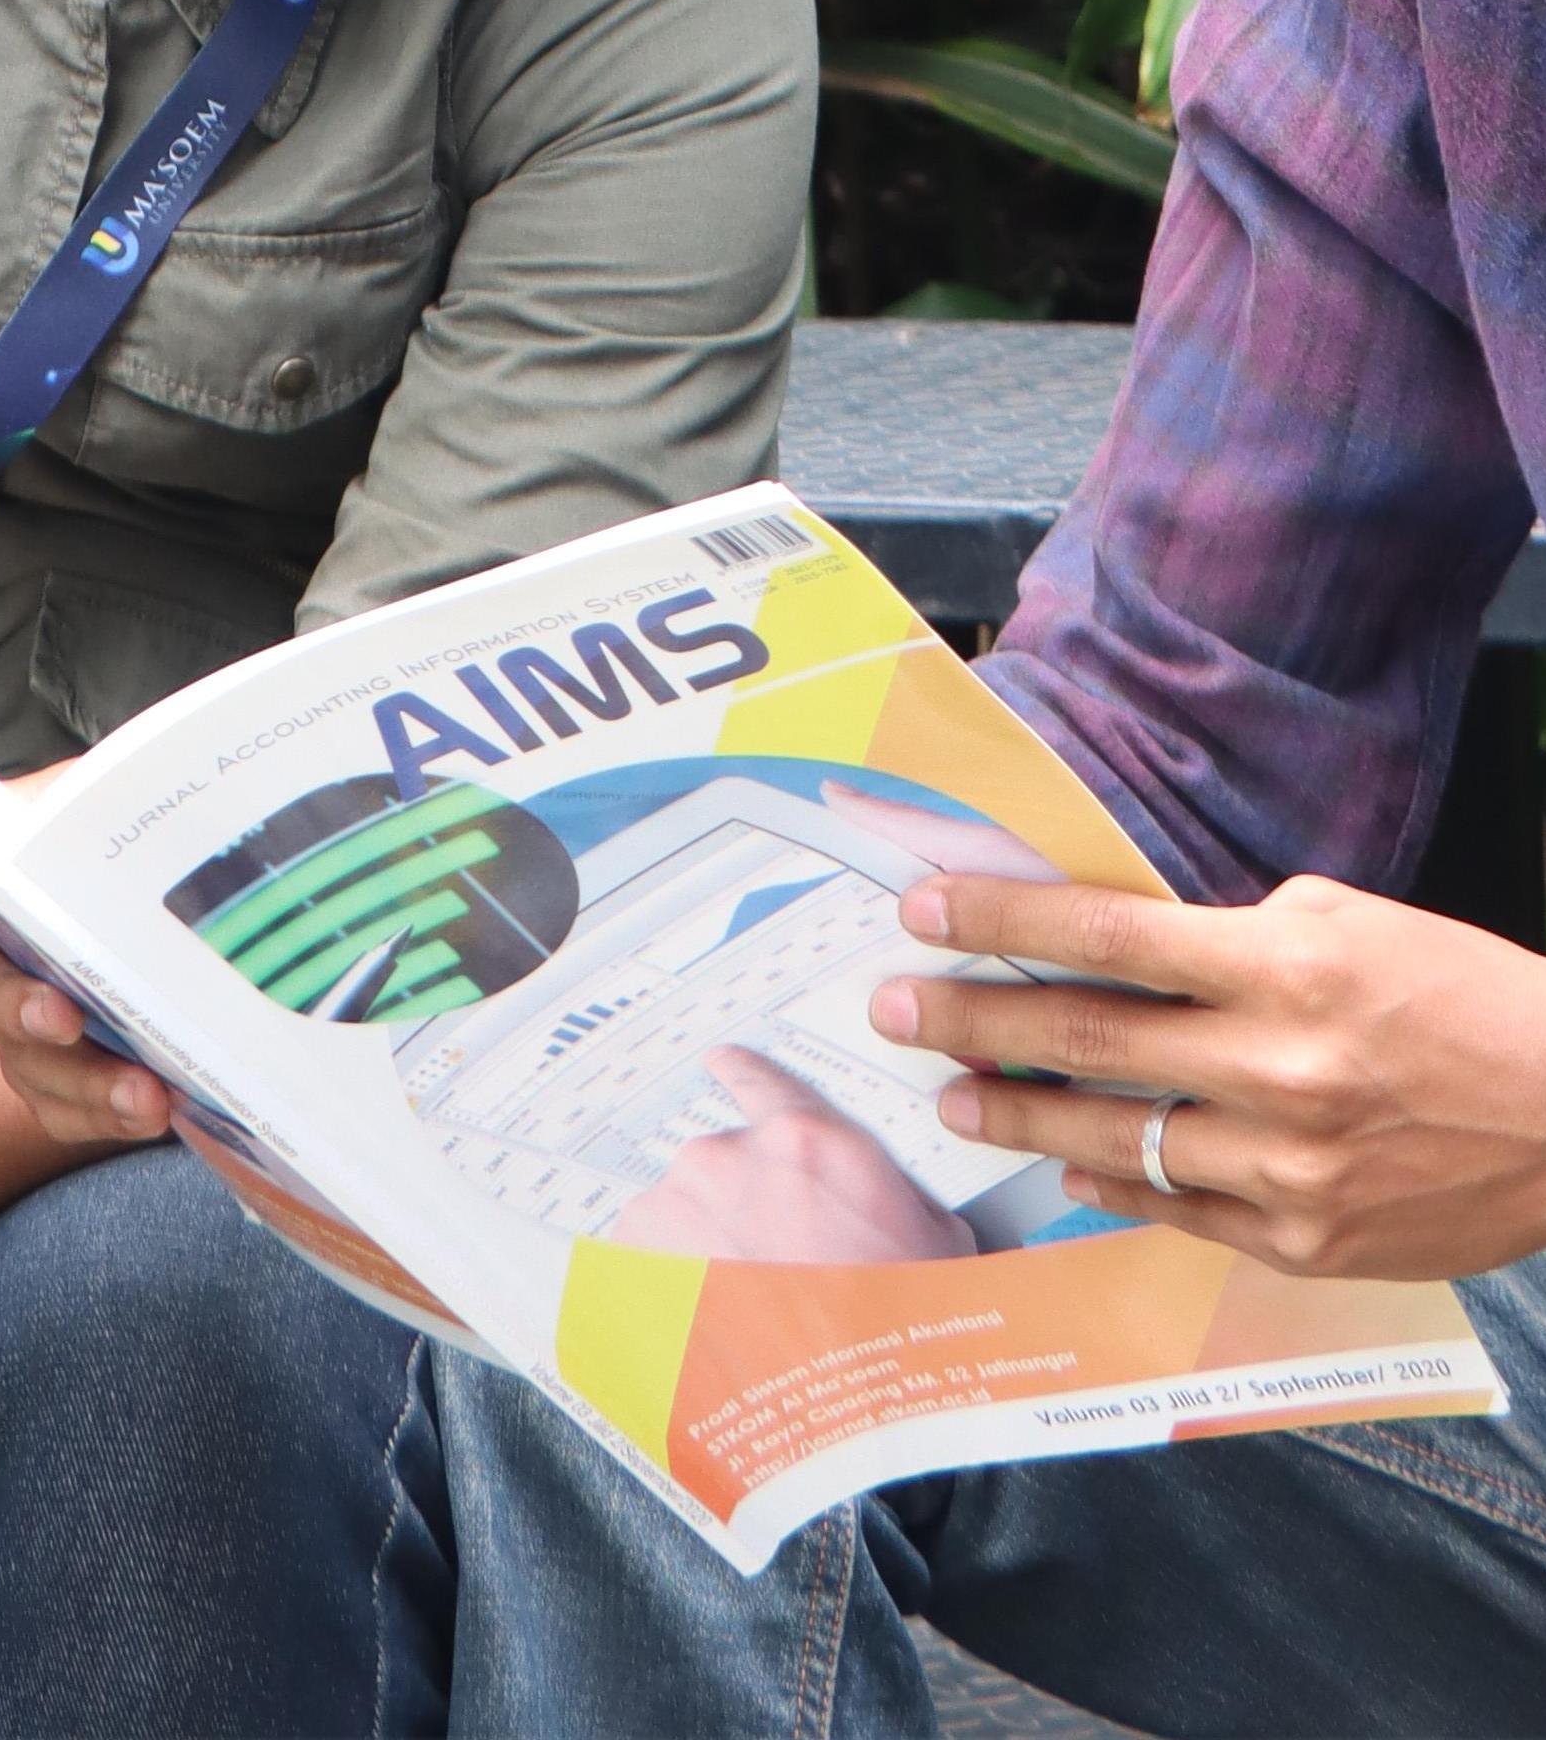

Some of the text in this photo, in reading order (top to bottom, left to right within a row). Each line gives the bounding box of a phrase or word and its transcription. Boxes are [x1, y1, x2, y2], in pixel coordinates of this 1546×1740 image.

[124, 99, 226, 231] MA'SOEM
[148, 118, 228, 226] UNIVERSITY
[104, 777, 210, 860] JURNAL
[215, 675, 392, 775] ACCOUNTING
[397, 610, 579, 680] INFORMATION
[582, 570, 697, 616] SYSTEM
[371, 587, 771, 803] AIMS
[69, 959, 105, 988] AIMS
[135, 1016, 198, 1071] Accounting
[197, 1065, 258, 1127] Information
[256, 1120, 300, 1158] System
[687, 1307, 1005, 1440] Prodi Sistem Informasi Akuntansi
[706, 1406, 778, 1457] STKOM
[805, 1358, 901, 1402] Ma'soem
[751, 1420, 805, 1455] Raya
[807, 1381, 903, 1425] Cipacing
[943, 1364, 973, 1385] 22
[976, 1350, 1079, 1379] Jatinangor
[1033, 1357, 1452, 1428] Volume 03 Jilid 2/ September/ 2020
